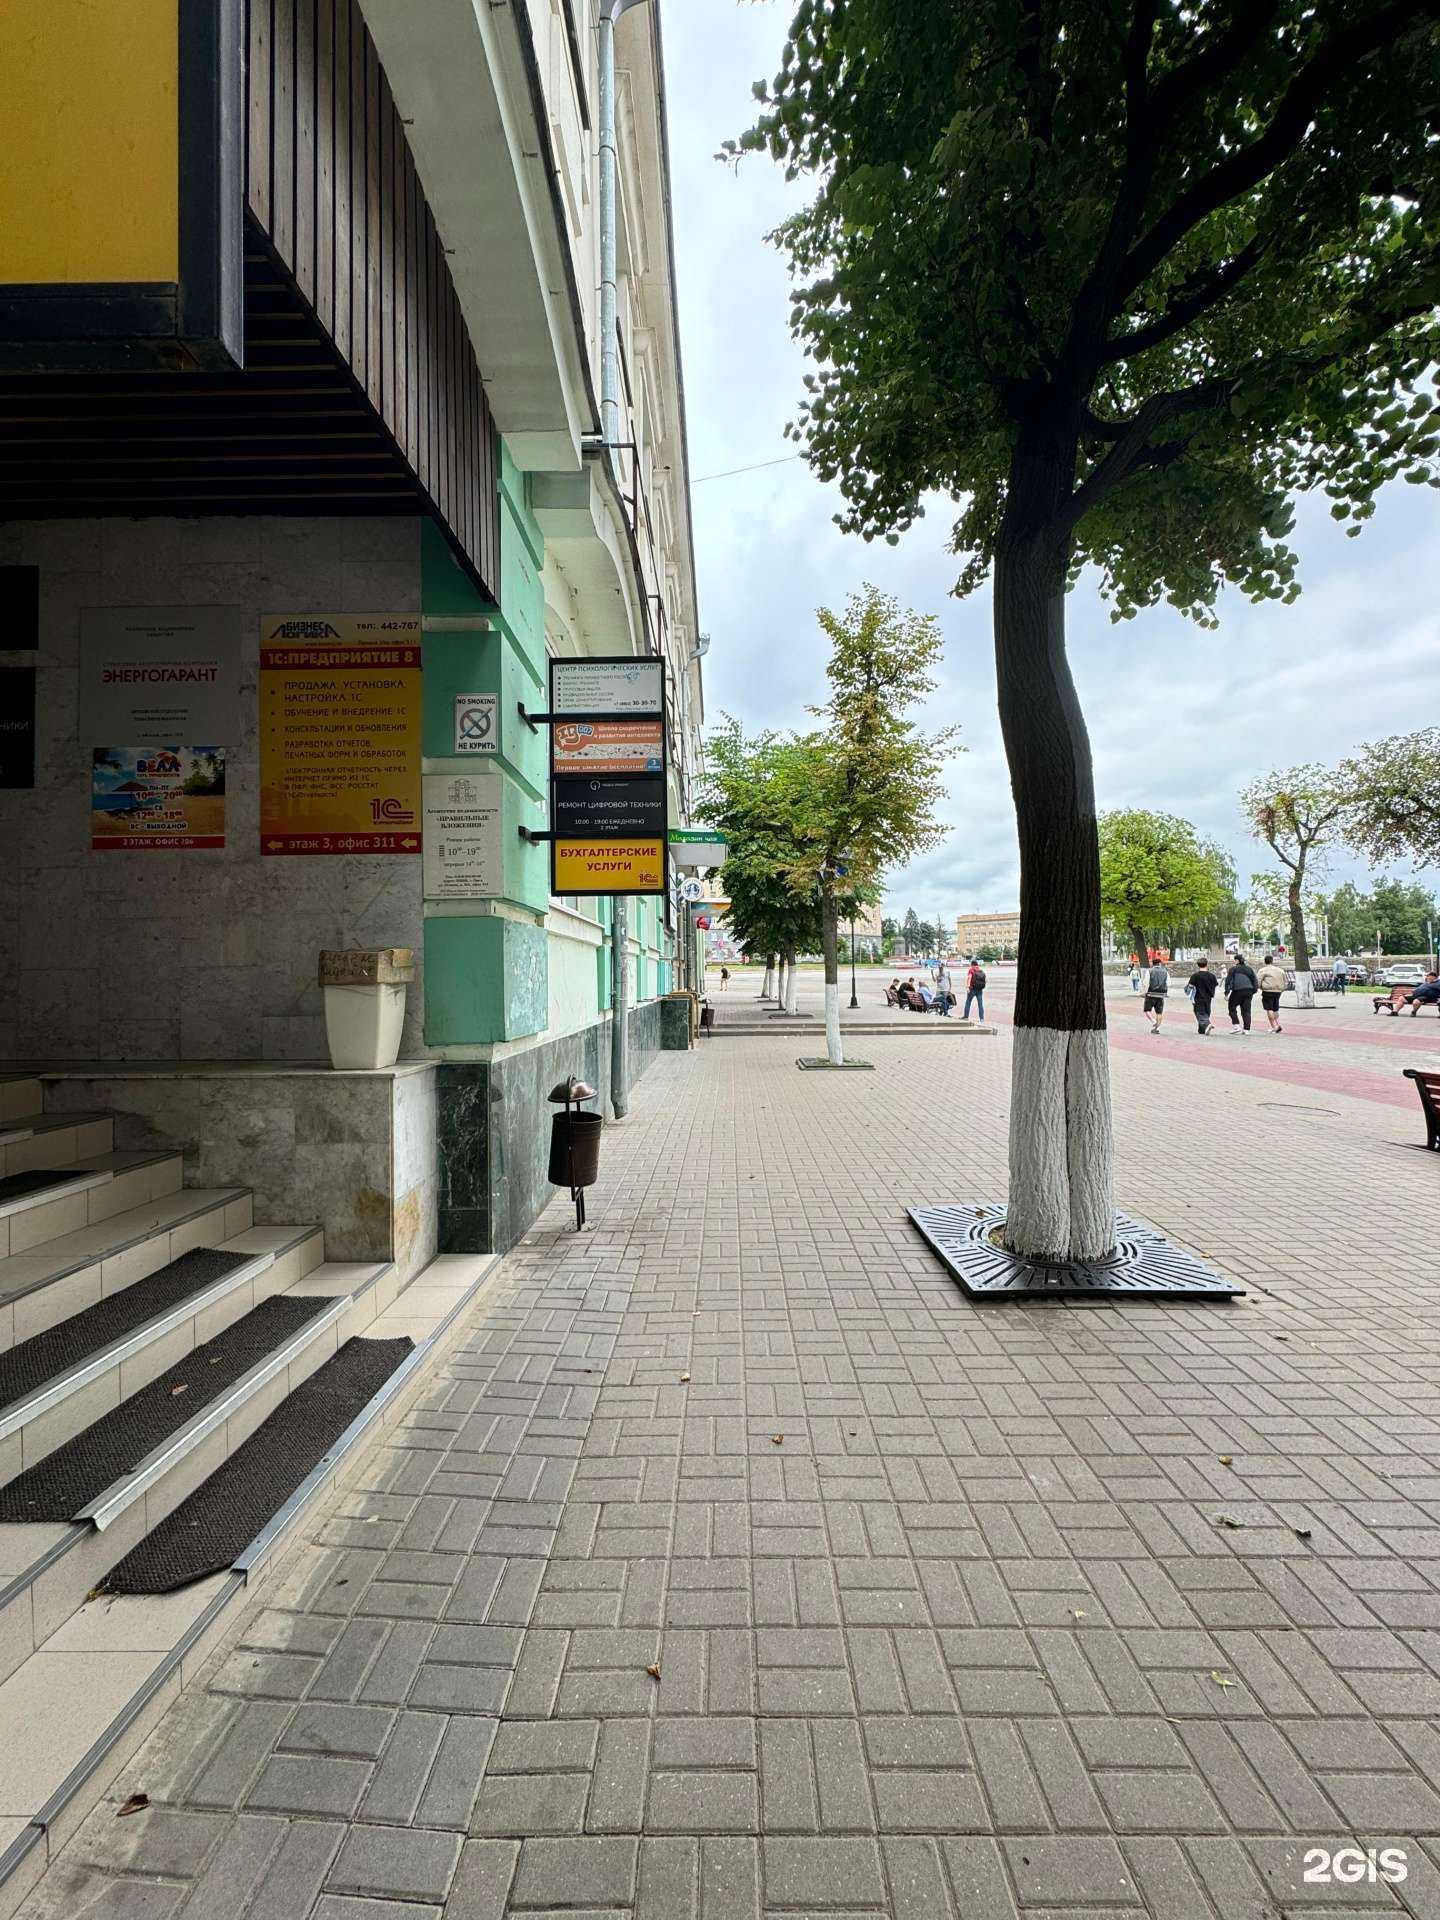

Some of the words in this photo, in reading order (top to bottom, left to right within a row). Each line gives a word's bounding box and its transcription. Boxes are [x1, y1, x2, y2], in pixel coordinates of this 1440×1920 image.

[287, 621, 325, 631] БИЗНЕС
[381, 621, 418, 630] 442-767
[269, 651, 400, 666] 1С:ПРЕДПРИЯТИЕ
[404, 650, 414, 663] 8
[557, 665, 577, 673] ЦЕНТР
[577, 664, 639, 672] ПСИХОЛОГИЧЕСКИХ
[102, 668, 218, 683] ЭНЕРГОГАРАНТ
[285, 692, 346, 703] НАСТРОЙКА
[285, 708, 329, 717] ОБУЧЕНИЕ
[342, 707, 393, 716] ВНЕДРЕНИЕ
[355, 724, 407, 733] ОБНОВЛЕНИЯ
[285, 740, 333, 749] РАЗРАБОТКА
[458, 742, 468, 750] НЕ
[469, 741, 496, 750] КУРИТЬ
[285, 751, 325, 760] ПЕЧАТНЫХ
[328, 750, 350, 759] ФОРМ
[361, 749, 407, 758] ОБРАБОТОК
[587, 801, 628, 810] ЦИФРОВОЙ
[629, 801, 662, 809] ТЕХНИКИ
[155, 838, 179, 847] ОФИС
[670, 834, 703, 842] Магазин
[288, 839, 320, 850] этаж
[323, 837, 335, 851] 3,
[338, 838, 370, 851] офис
[373, 836, 397, 849] 311
[560, 847, 657, 858] БУХГАЛТЕРСКИЕ
[586, 861, 632, 871] УСЛУГИ
